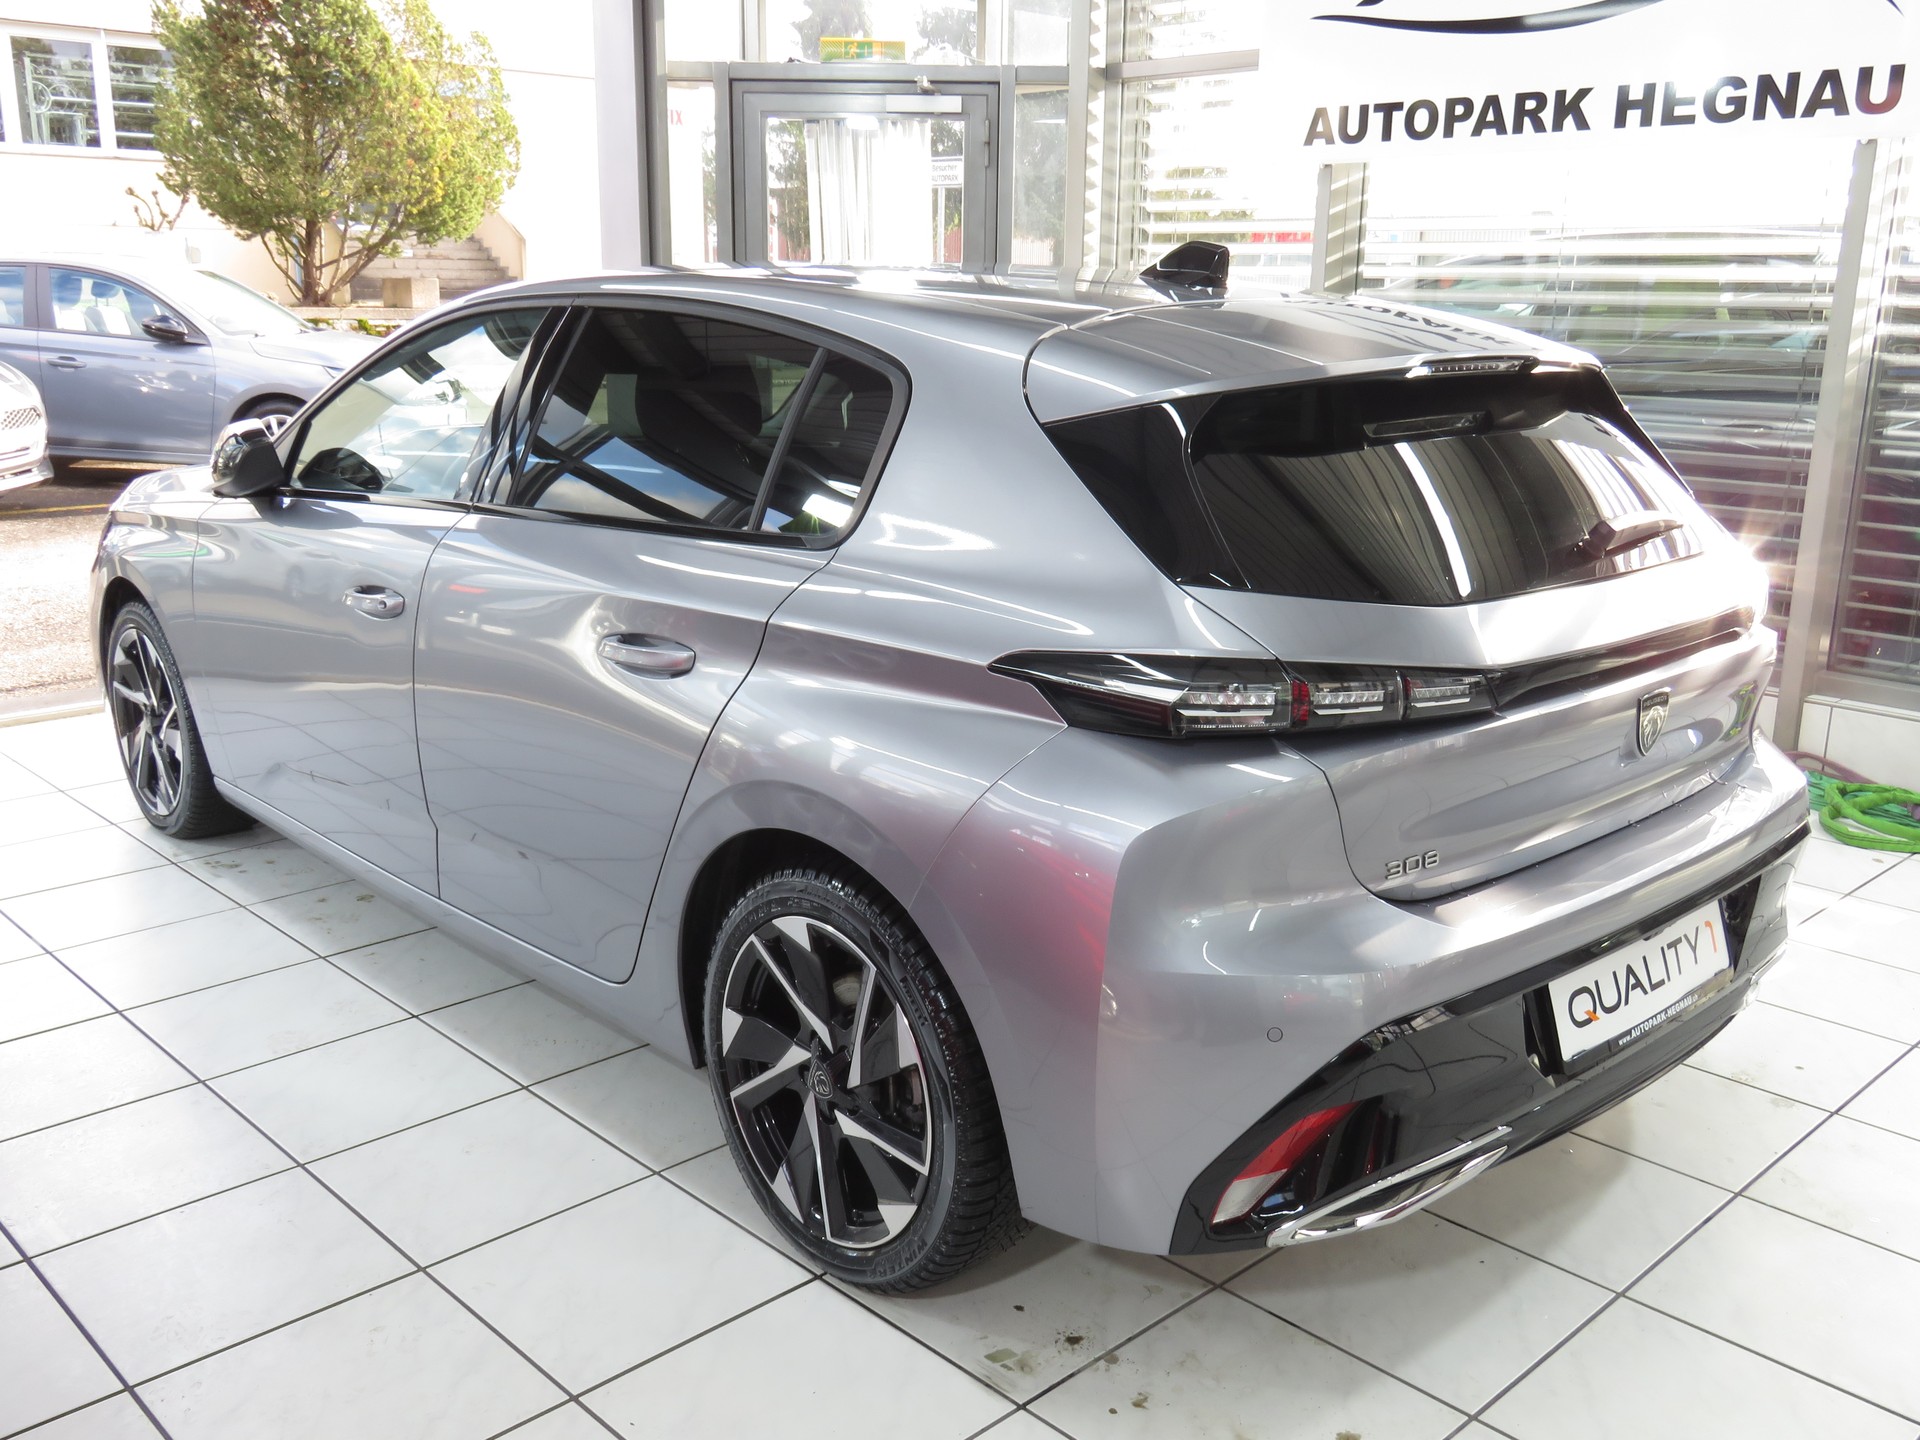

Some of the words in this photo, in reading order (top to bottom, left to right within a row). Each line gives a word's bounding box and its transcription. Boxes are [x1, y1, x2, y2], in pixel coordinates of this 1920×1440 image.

[1303, 86, 1595, 147] AUTOPARK
[1614, 63, 1907, 129] HEGNAU
[1385, 849, 1440, 880] 308
